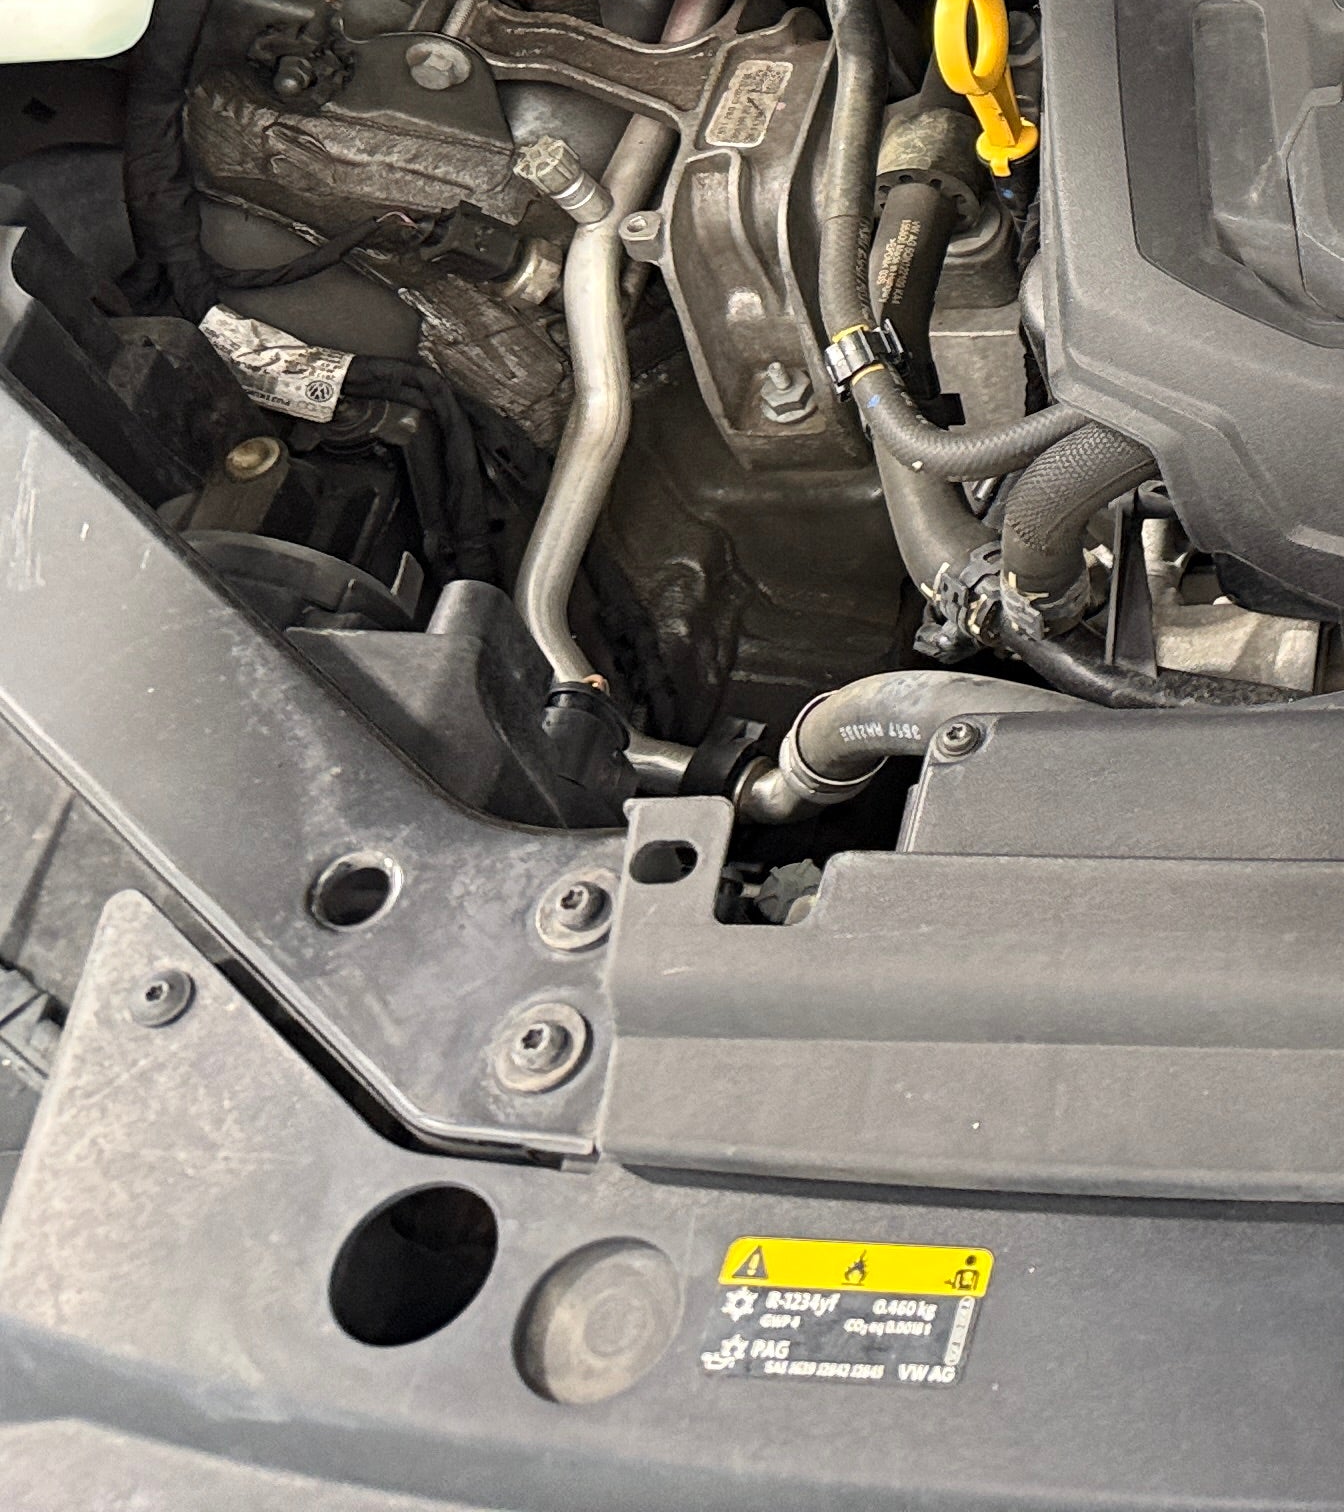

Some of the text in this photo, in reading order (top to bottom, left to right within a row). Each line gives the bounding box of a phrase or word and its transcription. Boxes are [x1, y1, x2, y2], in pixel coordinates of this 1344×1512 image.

[765, 1290, 938, 1321] R-1234yf 0.460 kg
[750, 1338, 791, 1360] PAG
[898, 1363, 956, 1384] VW AG
